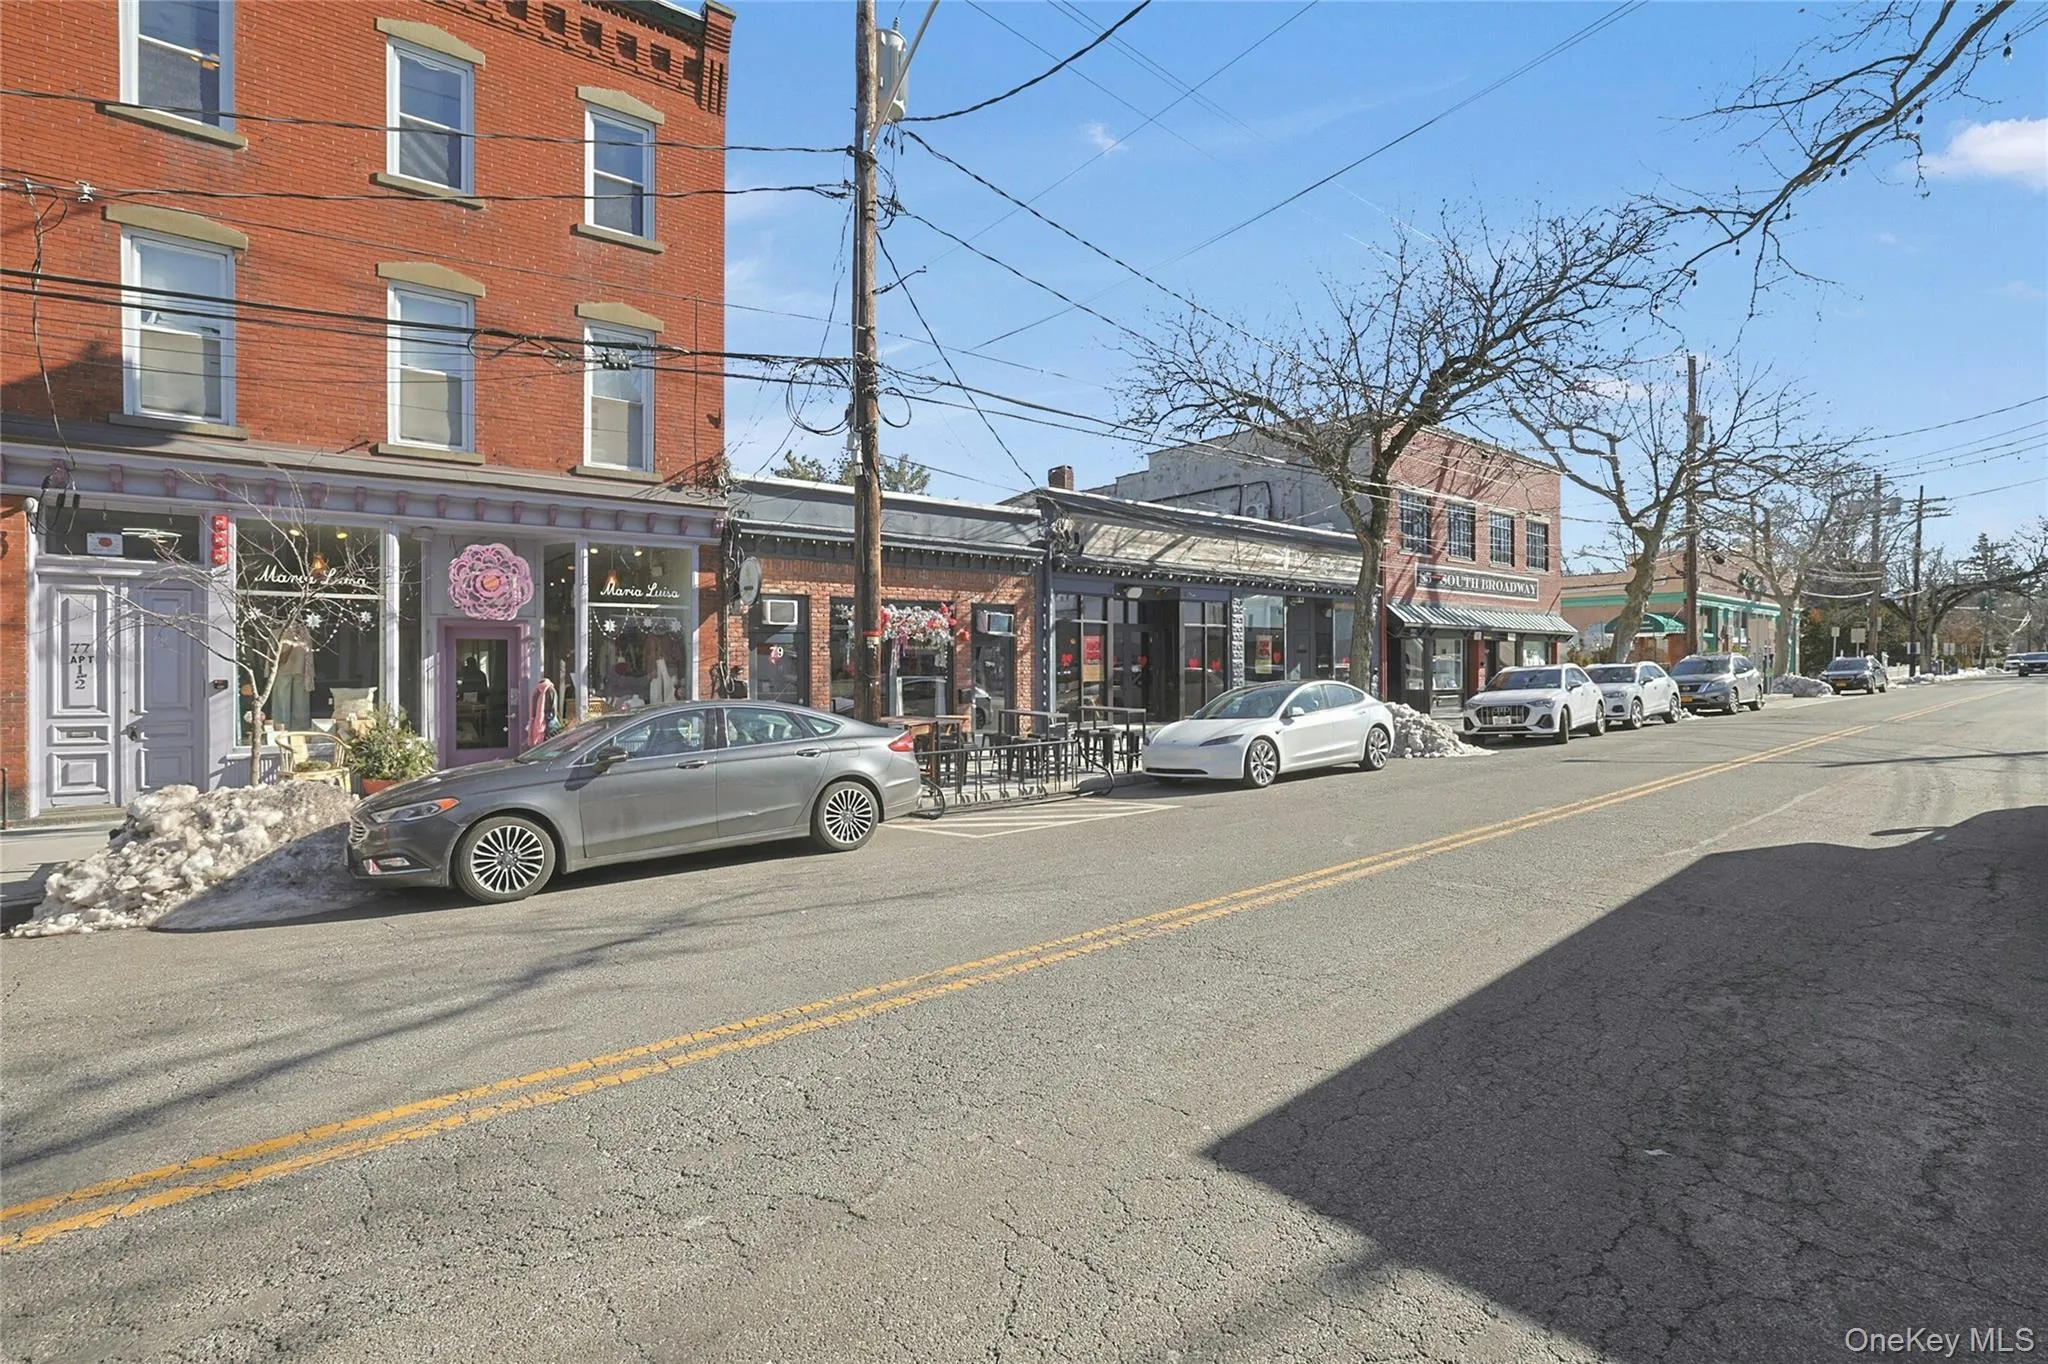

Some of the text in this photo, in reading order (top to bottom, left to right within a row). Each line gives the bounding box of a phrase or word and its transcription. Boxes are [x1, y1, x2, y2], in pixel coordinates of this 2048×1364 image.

[254, 564, 317, 585] Maria
[600, 582, 680, 598] Maria Luisa
[1440, 573, 1479, 589] SOUTH
[1481, 578, 1537, 595] BROADWAY
[70, 643, 90, 654] 77
[769, 646, 784, 658] 79
[70, 655, 95, 664] APT
[74, 679, 86, 690] 2
